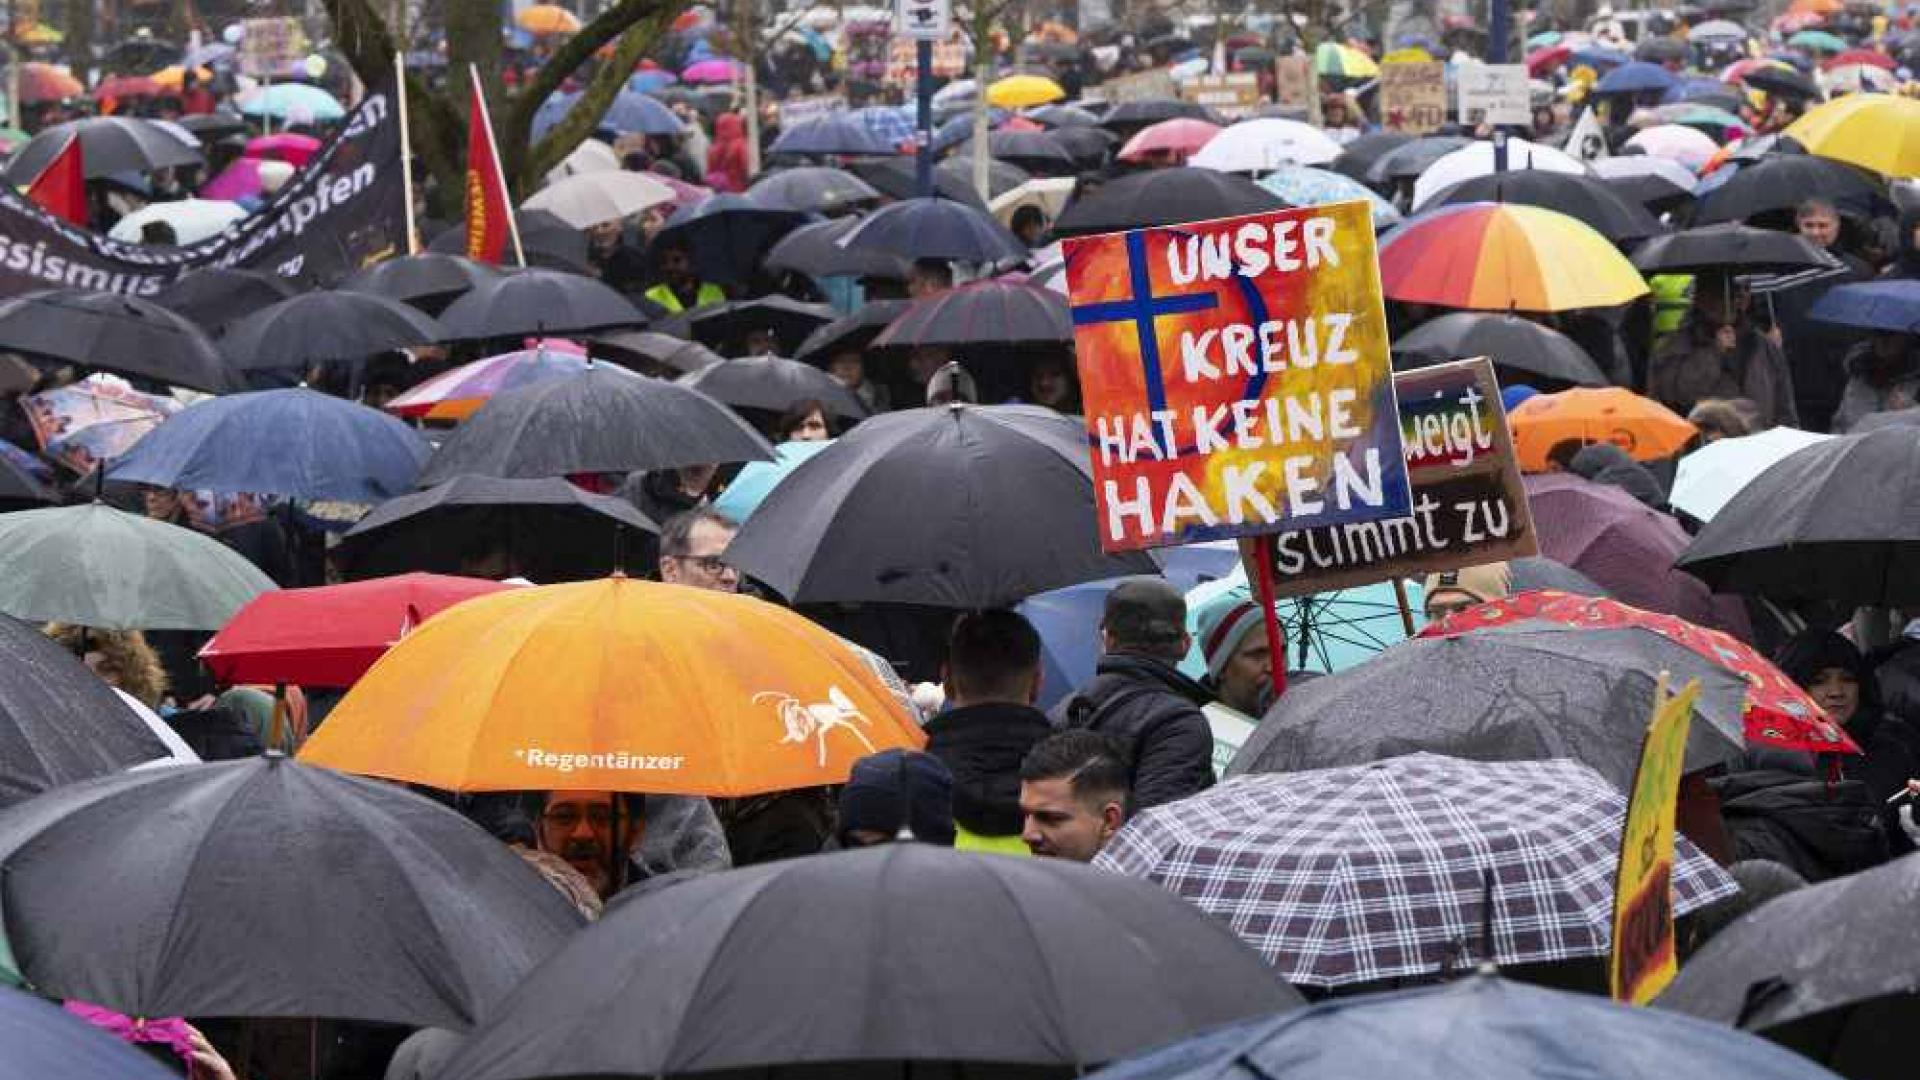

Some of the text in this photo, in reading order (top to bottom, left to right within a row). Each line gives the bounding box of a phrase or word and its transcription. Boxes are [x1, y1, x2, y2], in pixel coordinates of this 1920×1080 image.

[1167, 216, 1340, 284] UNSER
[1182, 313, 1360, 382] KREUZ
[1098, 389, 1362, 467] HAT KEINE
[1105, 448, 1383, 540] HAKEN
[1456, 498, 1509, 543] zu
